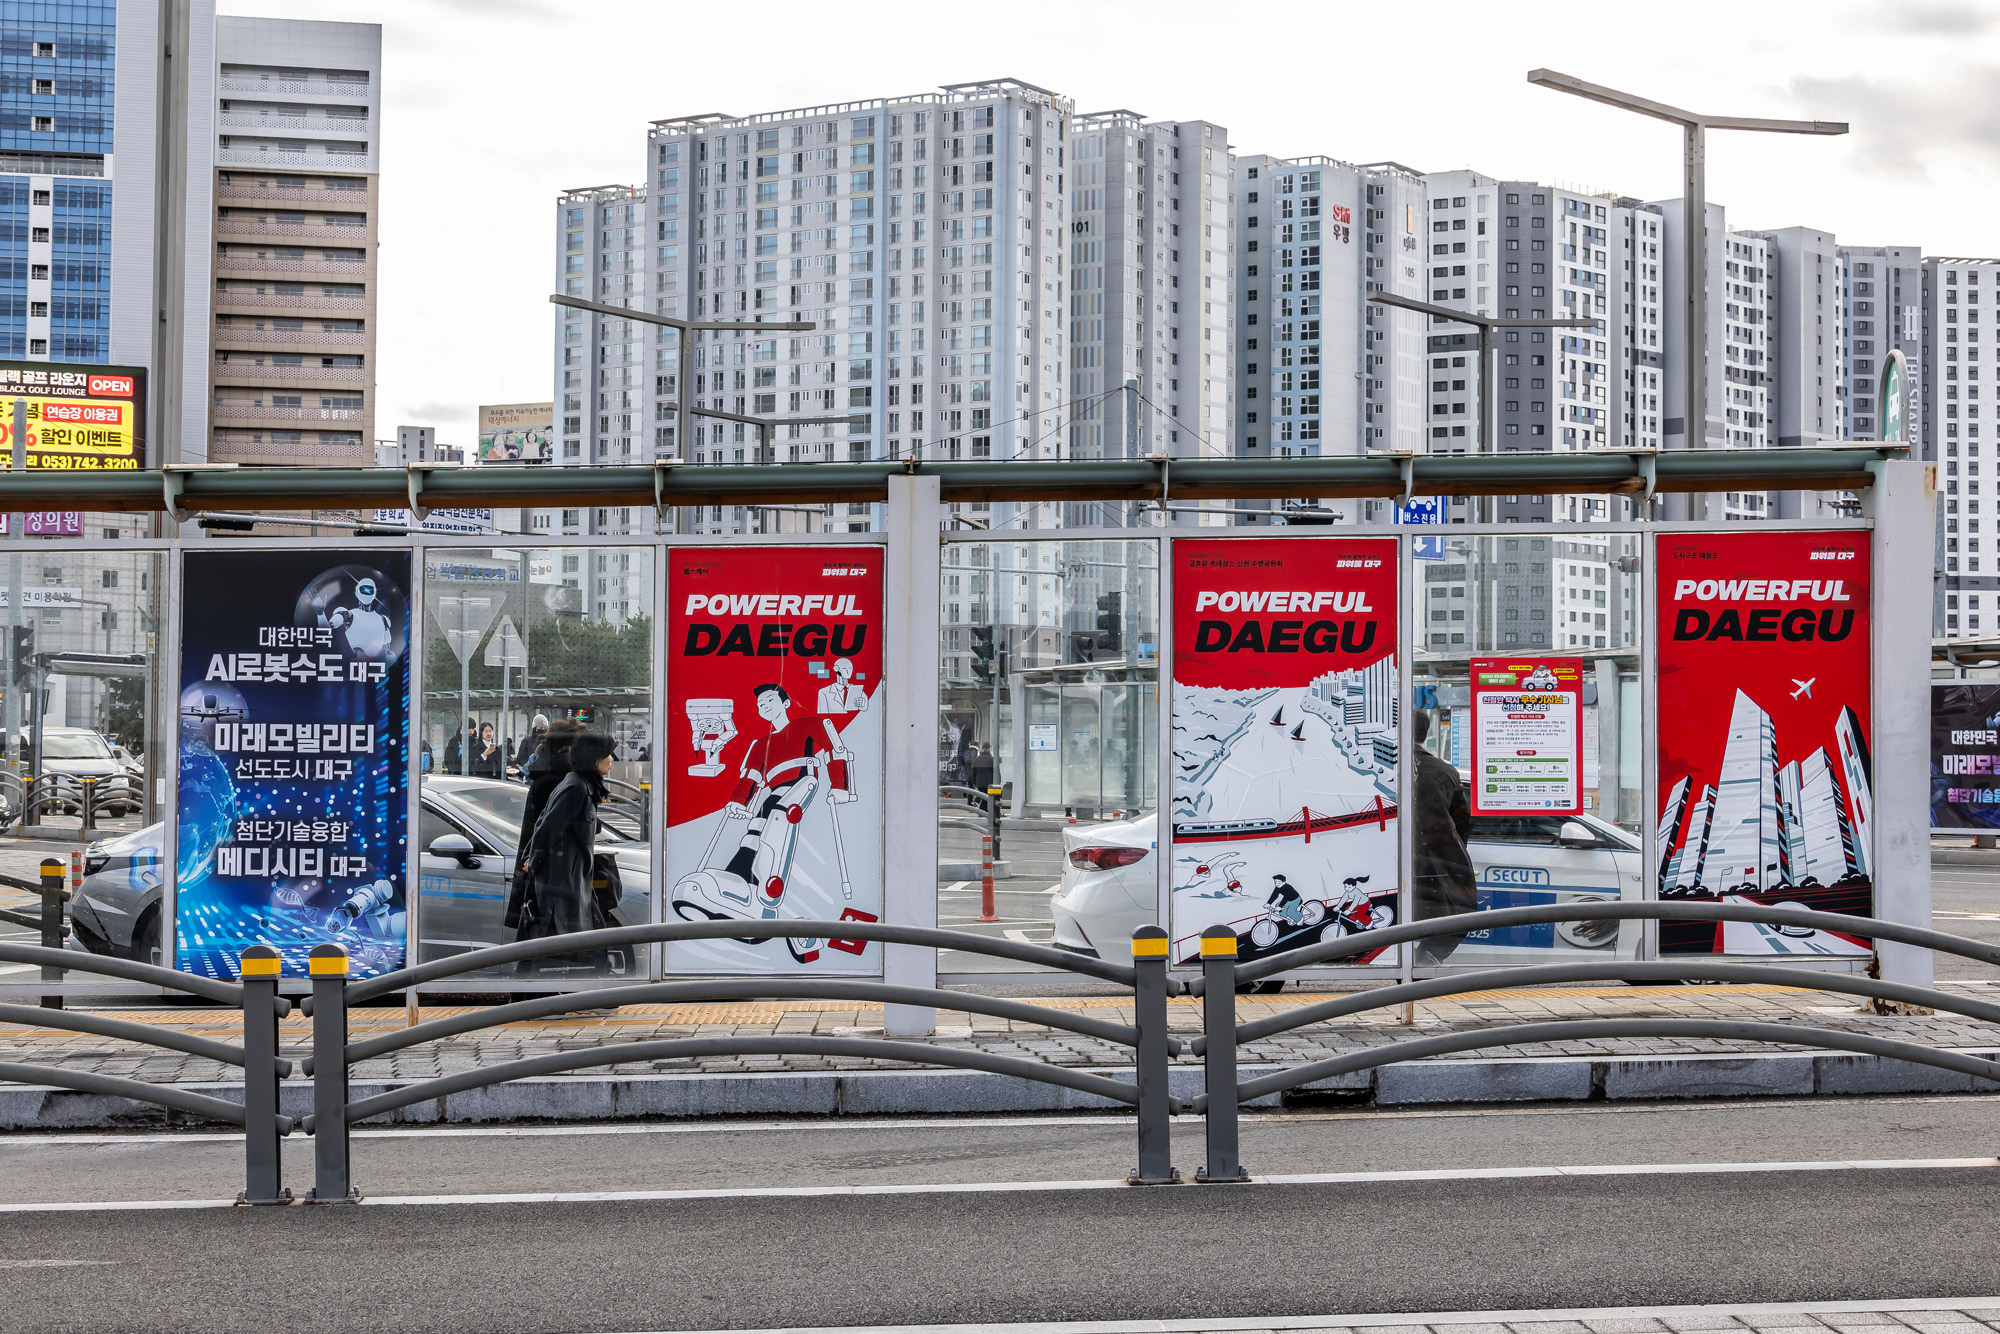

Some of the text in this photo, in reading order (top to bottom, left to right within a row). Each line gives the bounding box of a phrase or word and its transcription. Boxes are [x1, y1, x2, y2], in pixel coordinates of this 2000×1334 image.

[1333, 204, 1351, 224] SM
[1071, 221, 1089, 233] 101
[1333, 224, 1350, 244] 우방
[1404, 266, 1415, 278] 105
[22, 370, 48, 384] 골프
[50, 372, 87, 386] 라운지
[91, 379, 130, 392] OPEN
[28, 386, 51, 394] GOLF
[52, 388, 86, 396] LOUNGE
[46, 406, 82, 419] 연습장
[83, 408, 118, 421] 이용권
[488, 415, 520, 426] 대성에너지
[1908, 388, 1919, 444] SHARP
[41, 428, 122, 447] 할인 이벤트
[1404, 511, 1437, 524] 버스전용
[1336, 560, 1382, 568] 파워풀 대구
[1699, 552, 1719, 560] 재창조
[1810, 552, 1855, 560] 파워풀 대구
[683, 568, 709, 576] 헬스케어
[822, 568, 867, 576] 파워풀 대구
[1674, 579, 1850, 601] POWERFUL
[685, 594, 863, 616] POWERFUL
[1195, 591, 1373, 613] POWERFUL
[1673, 608, 1855, 642] DAEGU
[259, 627, 333, 648] 대한민국
[683, 623, 868, 657] DAEGU
[1194, 620, 1378, 654] DAEGU
[205, 653, 386, 683] AI로봇수도 대구
[1502, 704, 1550, 712] 선정해 주세요!
[1504, 696, 1520, 704] 택시
[214, 723, 375, 754] 미래모빌리티
[1951, 730, 1998, 745] 대한민국
[235, 759, 353, 780] 선도도시 대구
[236, 820, 350, 842] 첨단기술융합
[217, 848, 367, 877] 메디시티 대구
